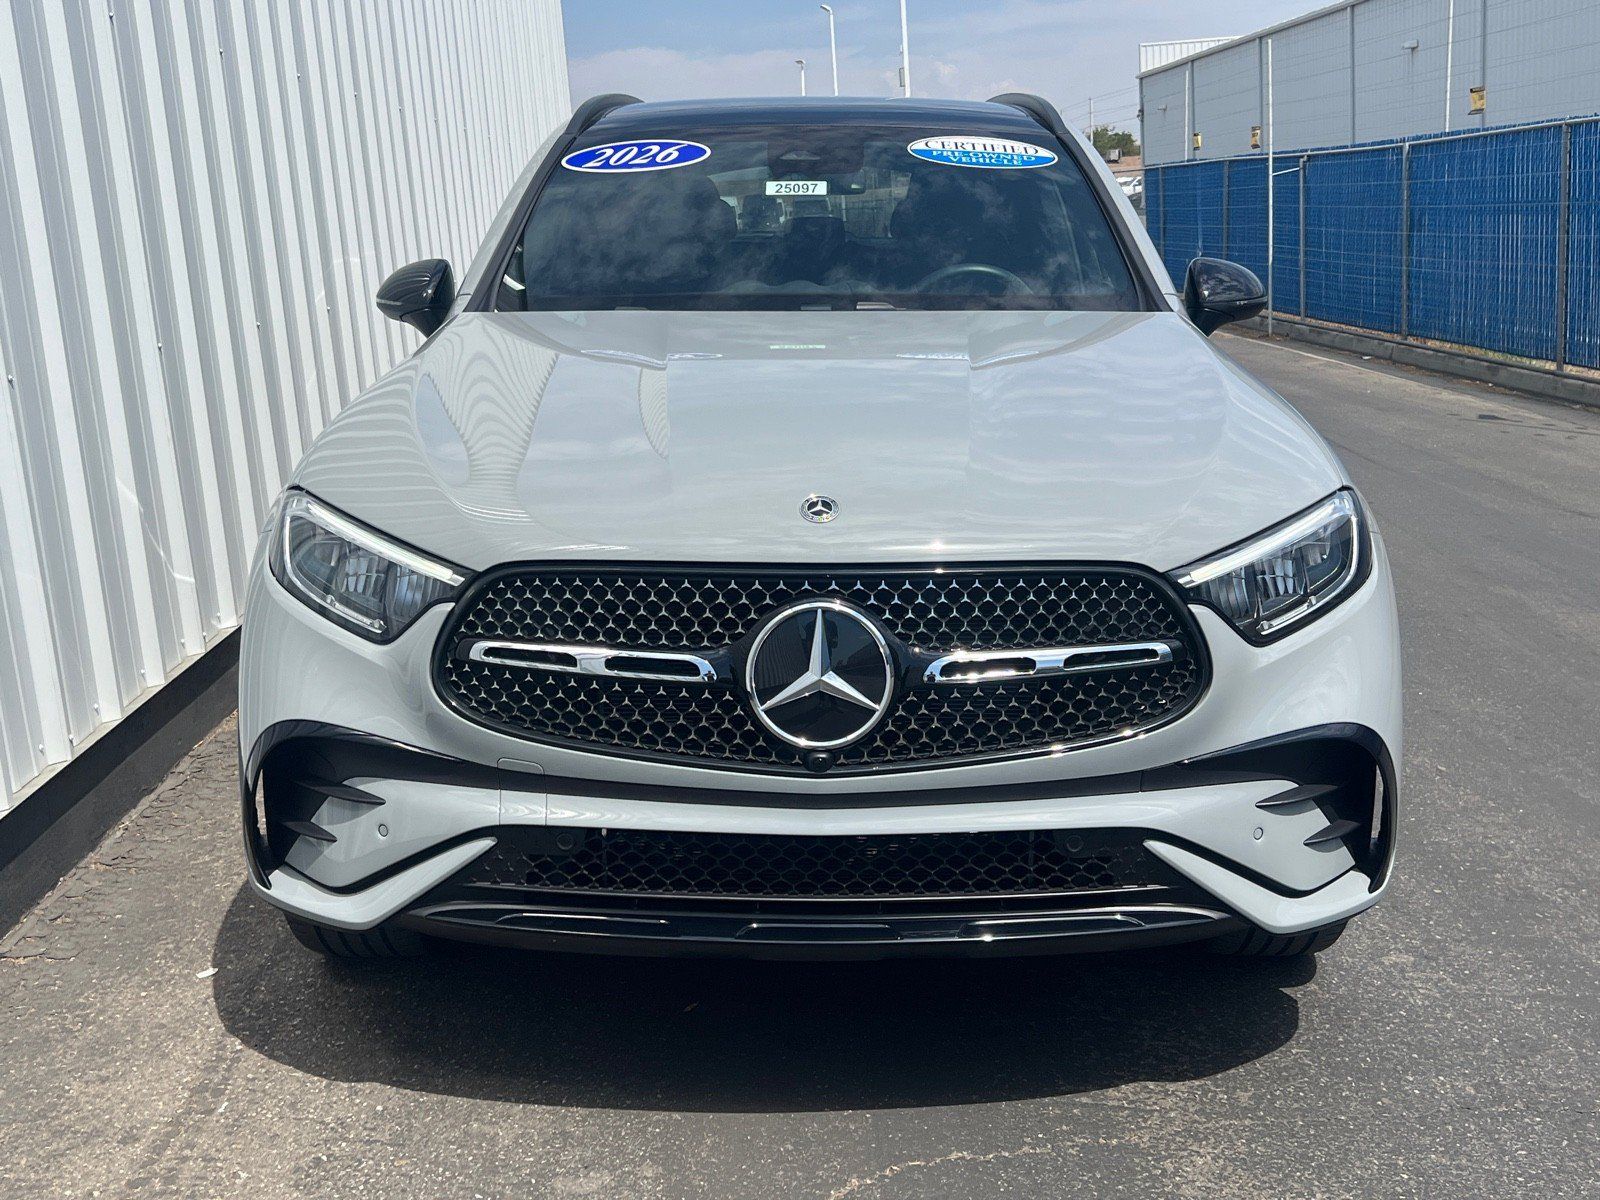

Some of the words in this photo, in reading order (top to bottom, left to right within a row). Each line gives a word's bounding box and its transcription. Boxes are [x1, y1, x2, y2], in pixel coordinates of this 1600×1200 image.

[925, 140, 1039, 156] CERTIFIED
[581, 143, 688, 168] 2026
[932, 150, 1036, 161] PRE-OWNED
[949, 156, 1023, 166] VEHICLE
[775, 183, 818, 194] 25097
